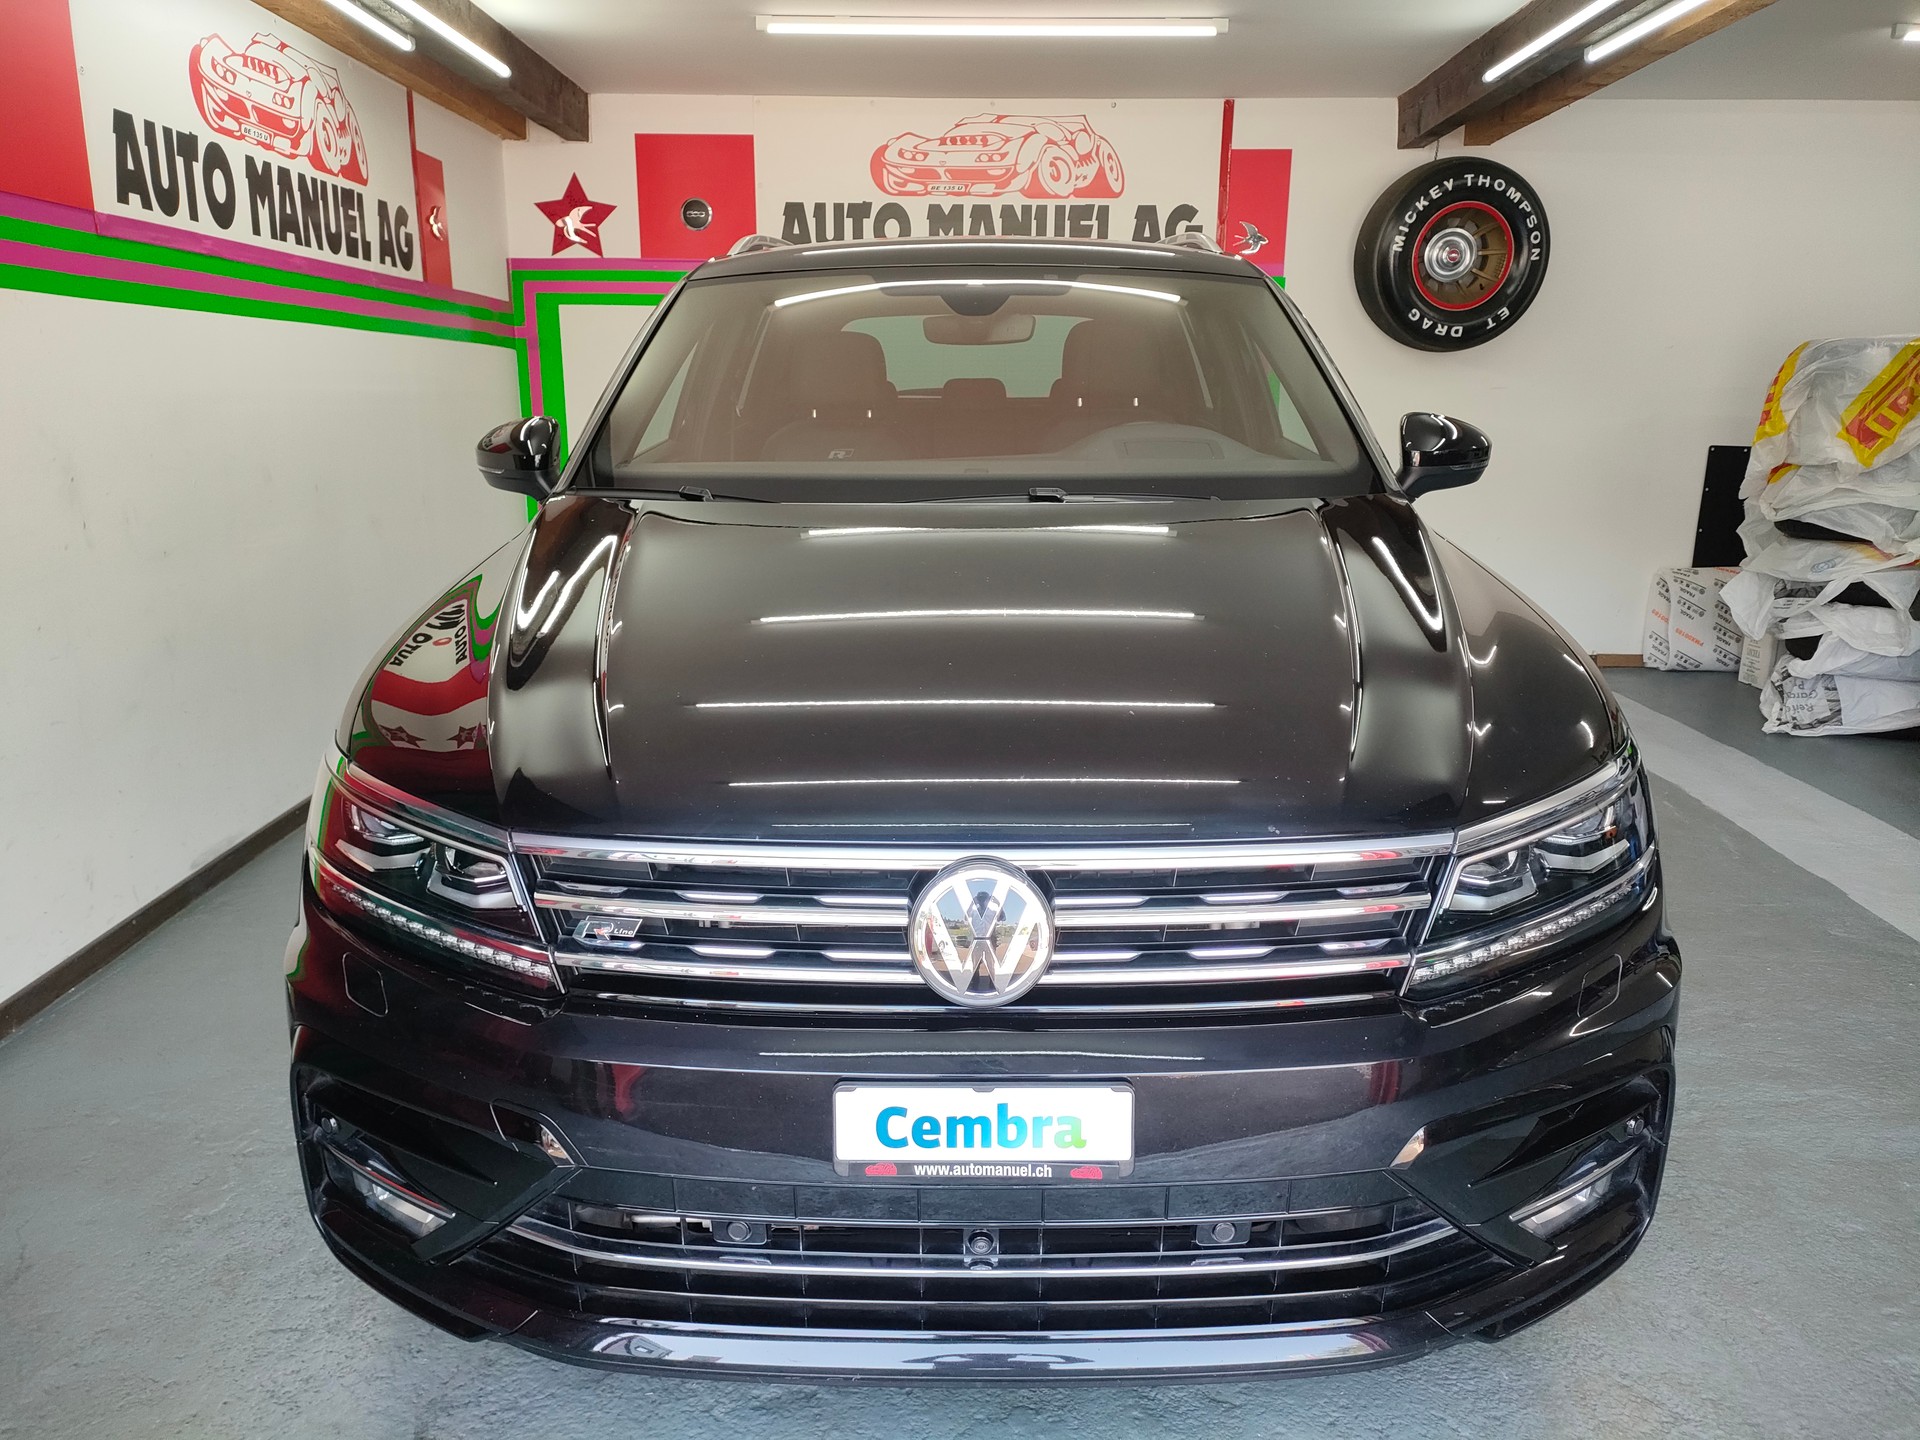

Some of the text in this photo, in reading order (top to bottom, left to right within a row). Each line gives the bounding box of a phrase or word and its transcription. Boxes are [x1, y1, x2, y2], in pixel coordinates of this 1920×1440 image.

[112, 107, 416, 273] AUTO MANUEL AG
[781, 200, 912, 245] AUTO
[1131, 203, 1204, 244] AG
[1392, 172, 1543, 262] MICKEY THOMPSON
[1407, 306, 1511, 338] ET DRAG
[875, 1102, 1088, 1149] Cembra
[914, 1162, 1053, 1178] www.automanuel.ch
